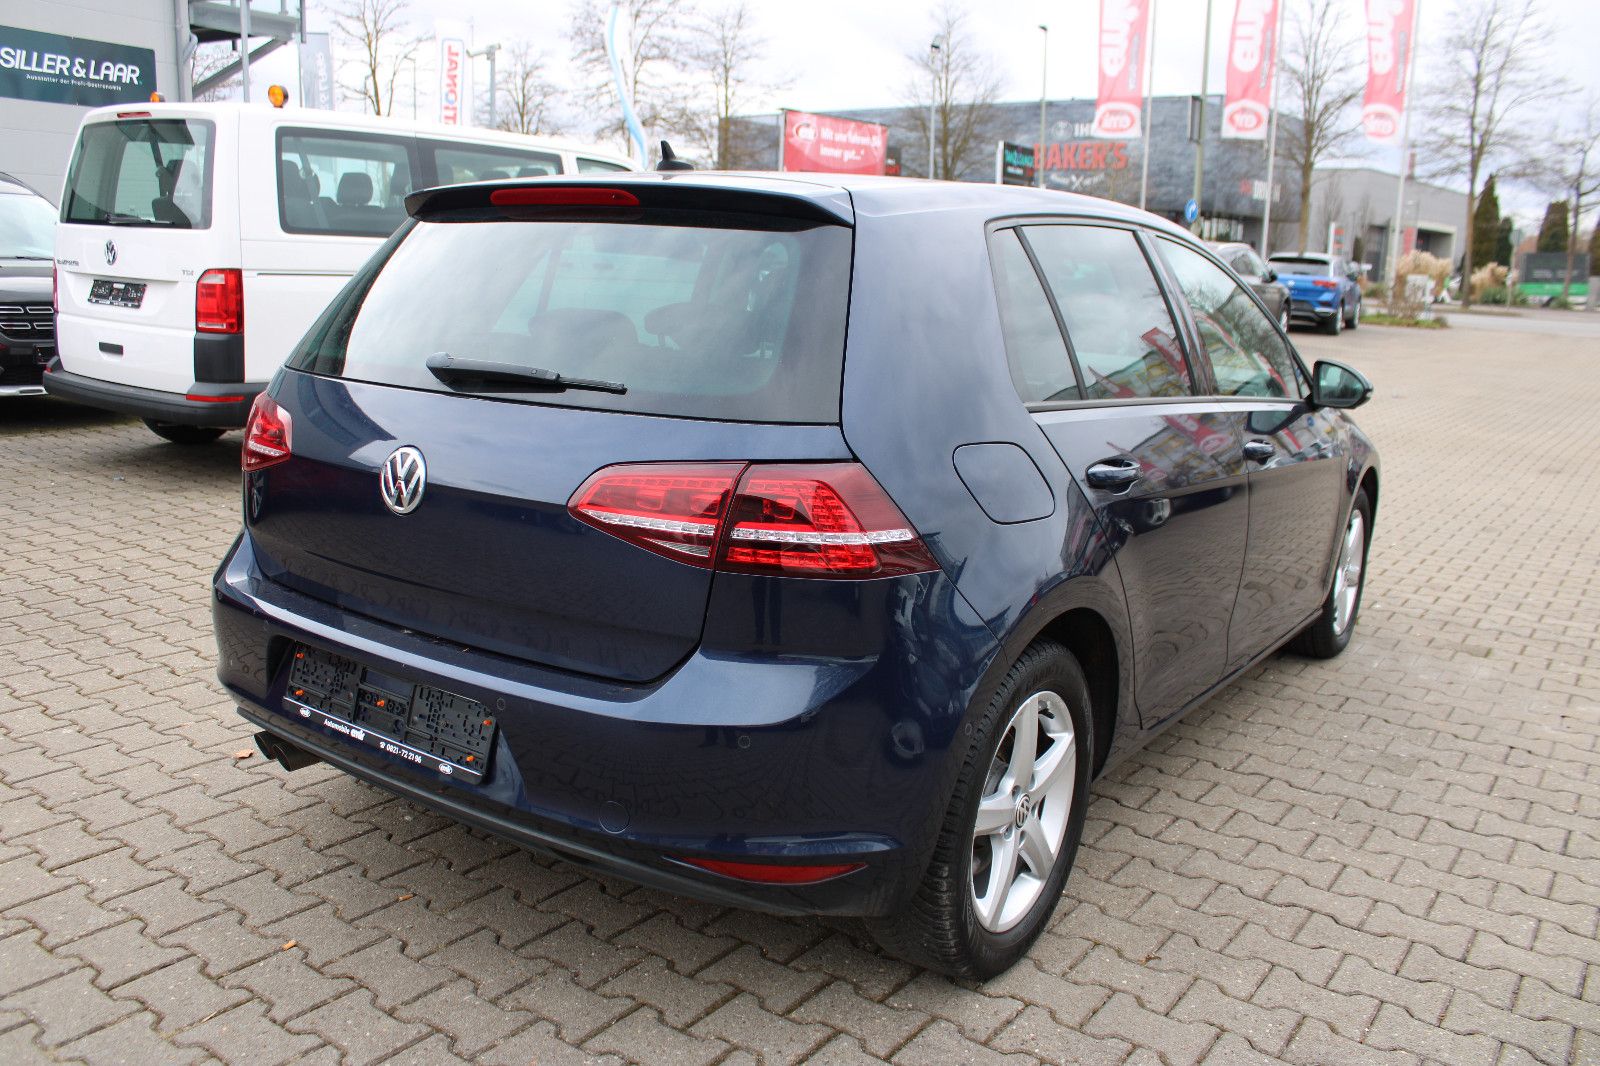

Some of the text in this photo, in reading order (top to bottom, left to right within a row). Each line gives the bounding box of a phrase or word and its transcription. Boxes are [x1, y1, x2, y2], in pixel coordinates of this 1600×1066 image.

[0, 47, 140, 86] SILLER & LAAR
[324, 718, 350, 734] Automobile
